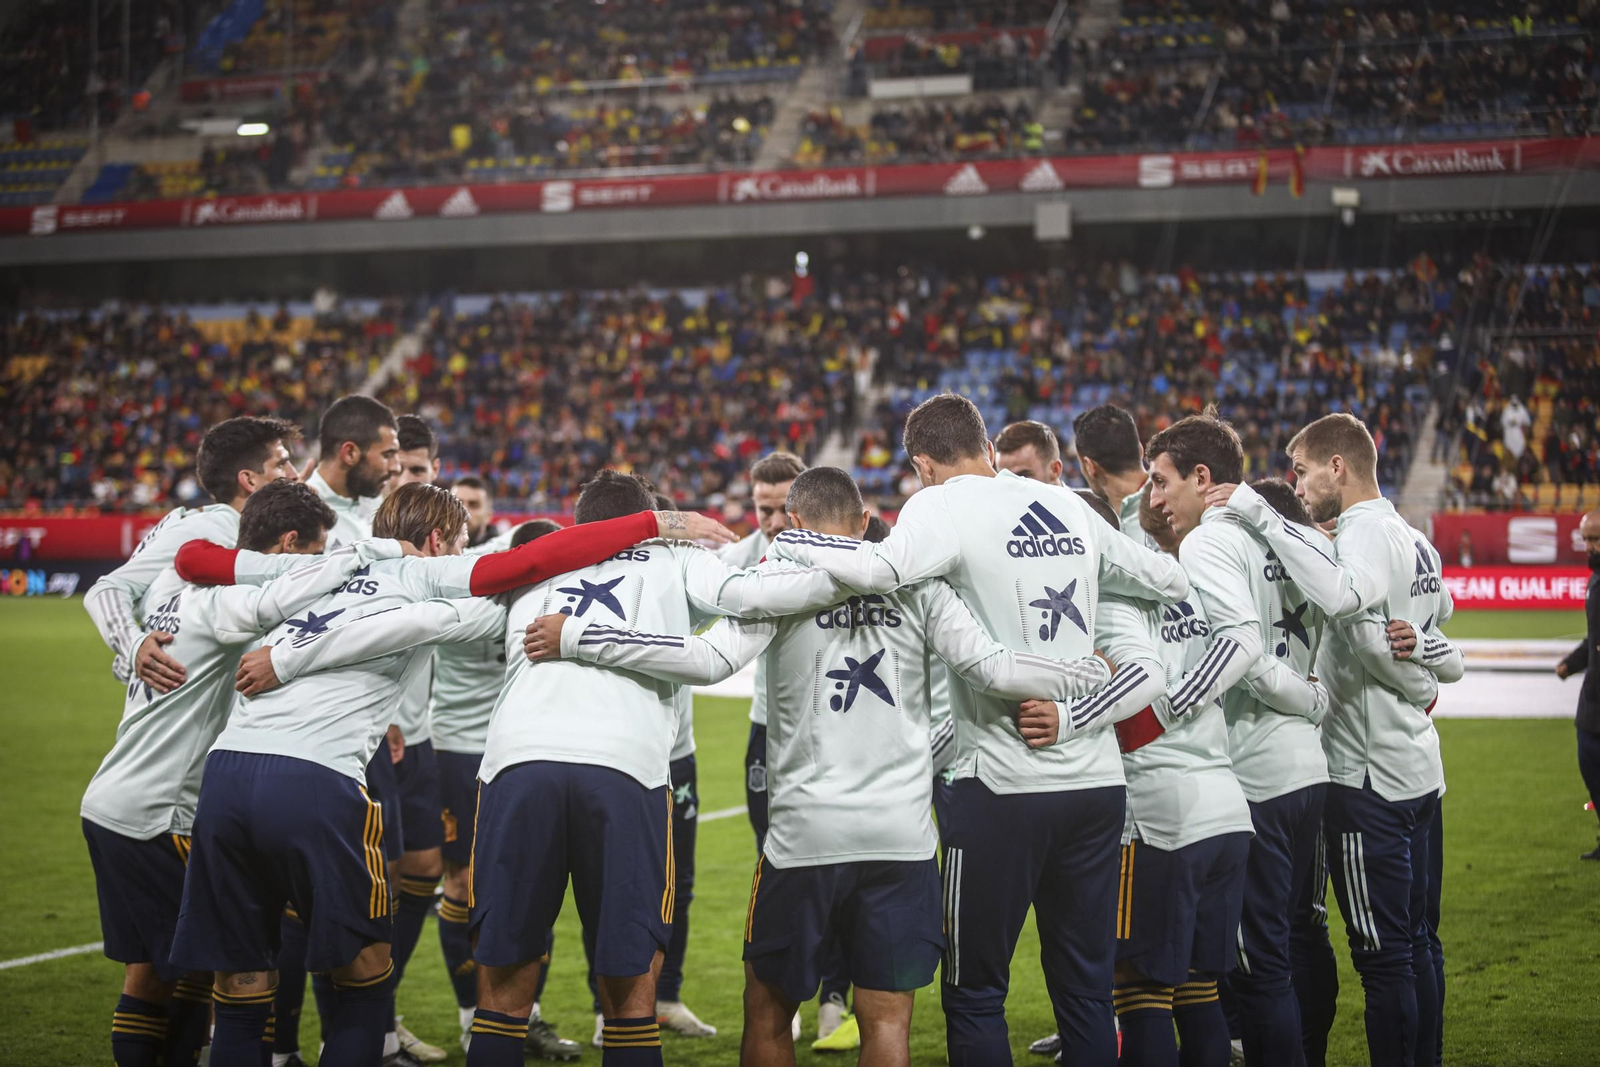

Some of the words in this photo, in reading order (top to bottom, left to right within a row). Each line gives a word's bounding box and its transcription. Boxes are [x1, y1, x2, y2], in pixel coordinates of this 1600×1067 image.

[1393, 147, 1506, 174] CaixaBank
[1006, 534, 1086, 558] adidas
[1500, 576, 1587, 600] QUALIFIE
[815, 602, 902, 629] adidas
